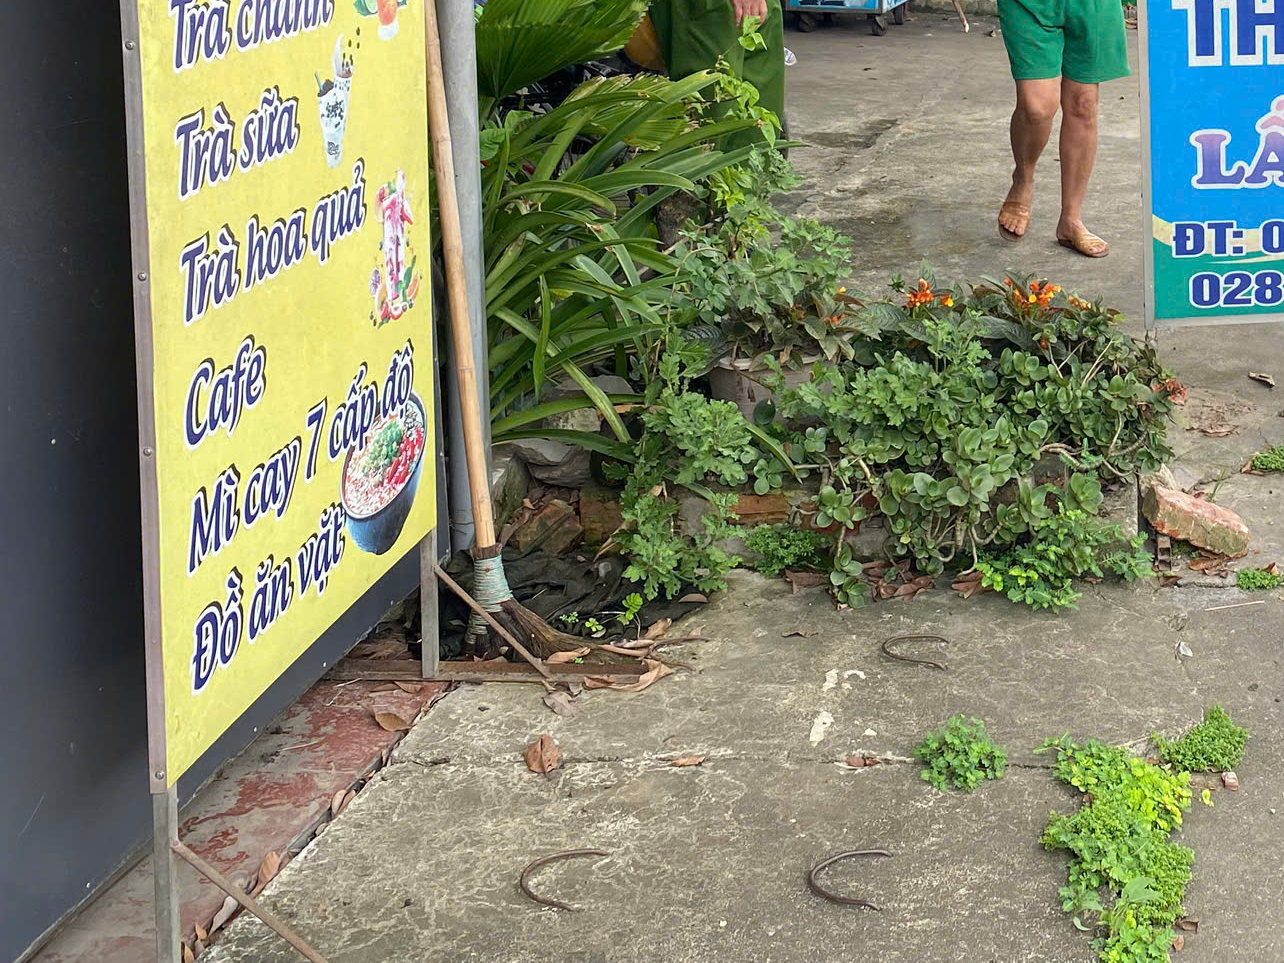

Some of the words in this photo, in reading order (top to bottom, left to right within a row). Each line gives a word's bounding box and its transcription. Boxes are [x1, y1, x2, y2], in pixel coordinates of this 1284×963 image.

[176, 104, 235, 198] Trà
[240, 86, 298, 169] sữa
[180, 225, 239, 325] Trà
[244, 208, 306, 293] hoa
[311, 160, 367, 263] quả
[1172, 221, 1244, 257] ĐT:
[186, 337, 266, 448] Cafe
[188, 465, 239, 576] Mì
[244, 437, 302, 525] cay
[306, 401, 327, 481] 7
[328, 364, 380, 453] cấp
[381, 340, 414, 418] độ
[191, 571, 244, 694] Đồ
[249, 555, 293, 639] ăn
[297, 505, 346, 598] vặt
